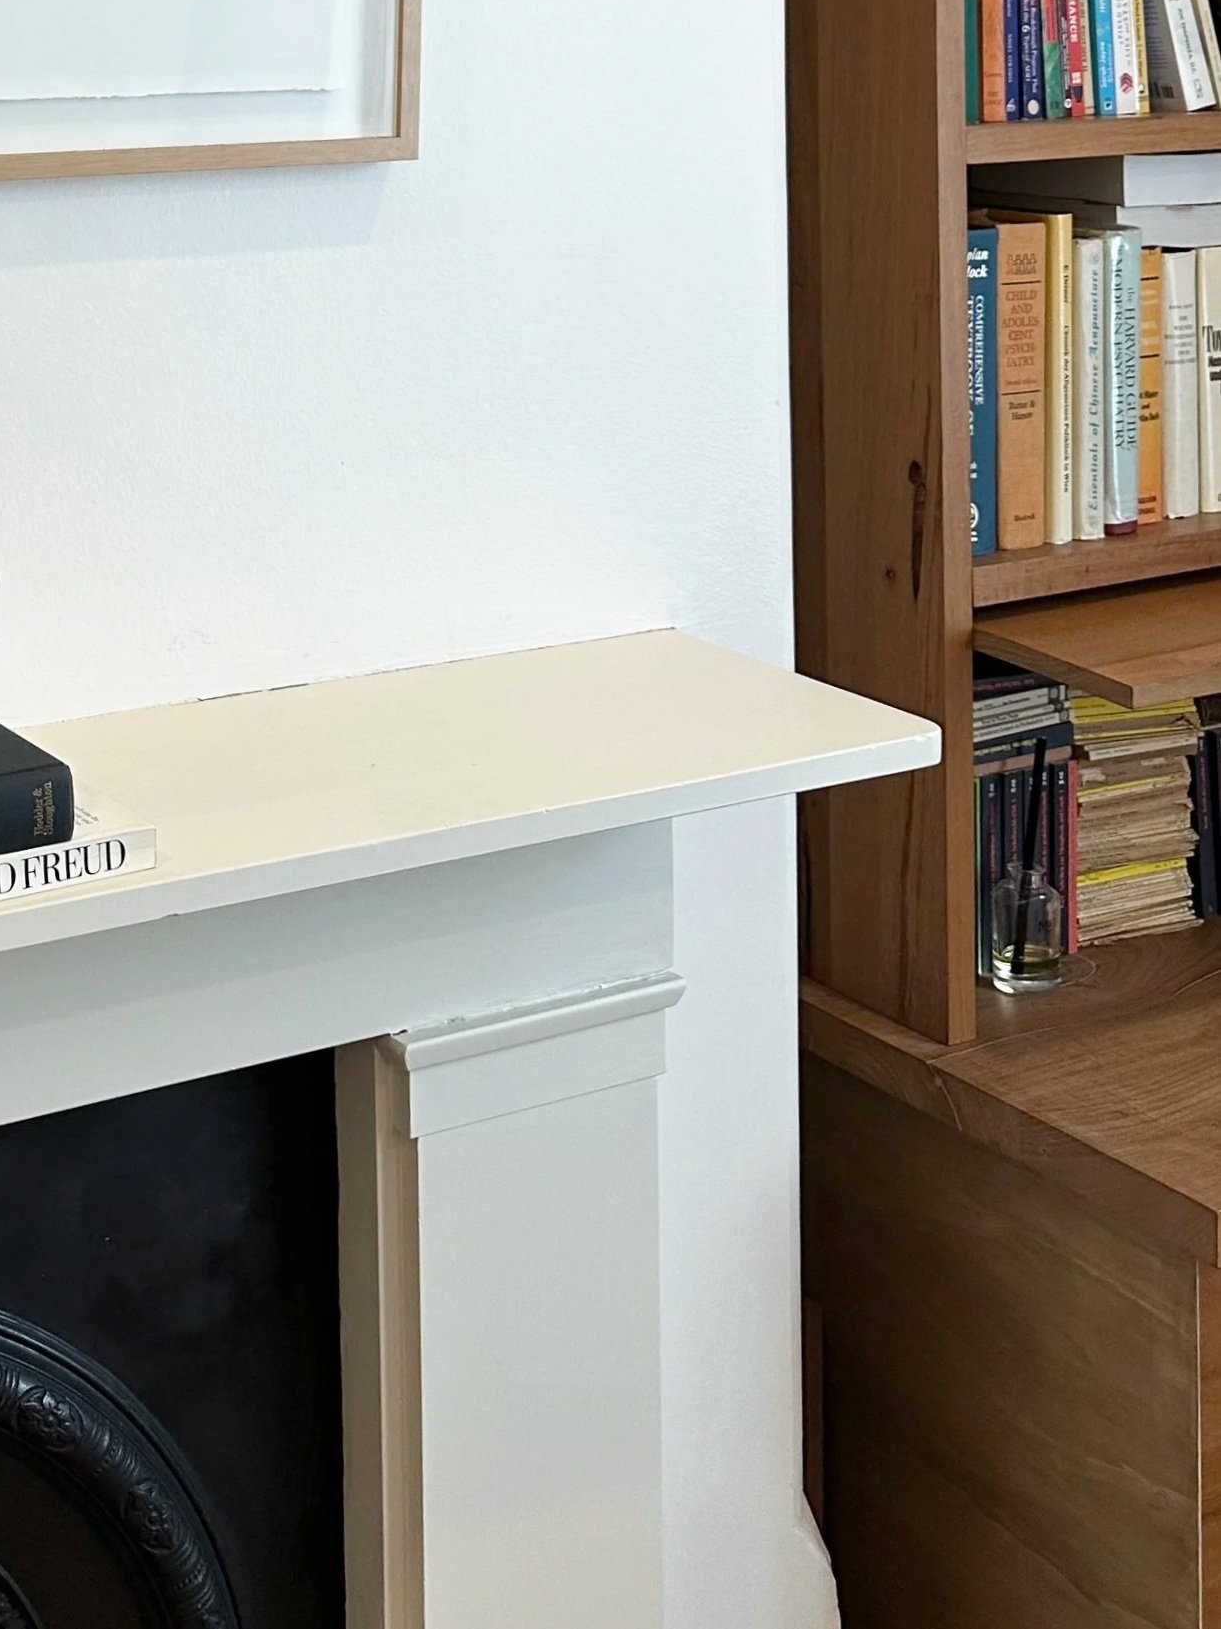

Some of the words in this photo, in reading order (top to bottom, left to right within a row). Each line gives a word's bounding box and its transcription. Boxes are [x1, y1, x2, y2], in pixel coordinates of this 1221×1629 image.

[1021, 24, 1030, 32] 6
[1099, 41, 1107, 88] Sarah-Jayne
[1005, 290, 1038, 302] CHILD
[1010, 303, 1033, 315] AND
[1087, 269, 1100, 357] Acupuncture
[1114, 258, 1125, 335] MODERN
[974, 295, 985, 406] COMPREHENSIVE
[1007, 329, 1035, 341] CENT
[1124, 307, 1136, 388] HARVARD
[1005, 355, 1036, 368] IATRY
[1087, 363, 1099, 416] Chinese
[1115, 341, 1126, 450] PSYCHIATRY
[1089, 422, 1100, 437] of
[1125, 393, 1137, 450] GUIDE
[1087, 443, 1099, 510] Essentials
[32, 786, 43, 798] &
[32, 799, 44, 837] Hodder
[41, 779, 54, 836] Stoughton
[22, 839, 127, 891] FREUD
